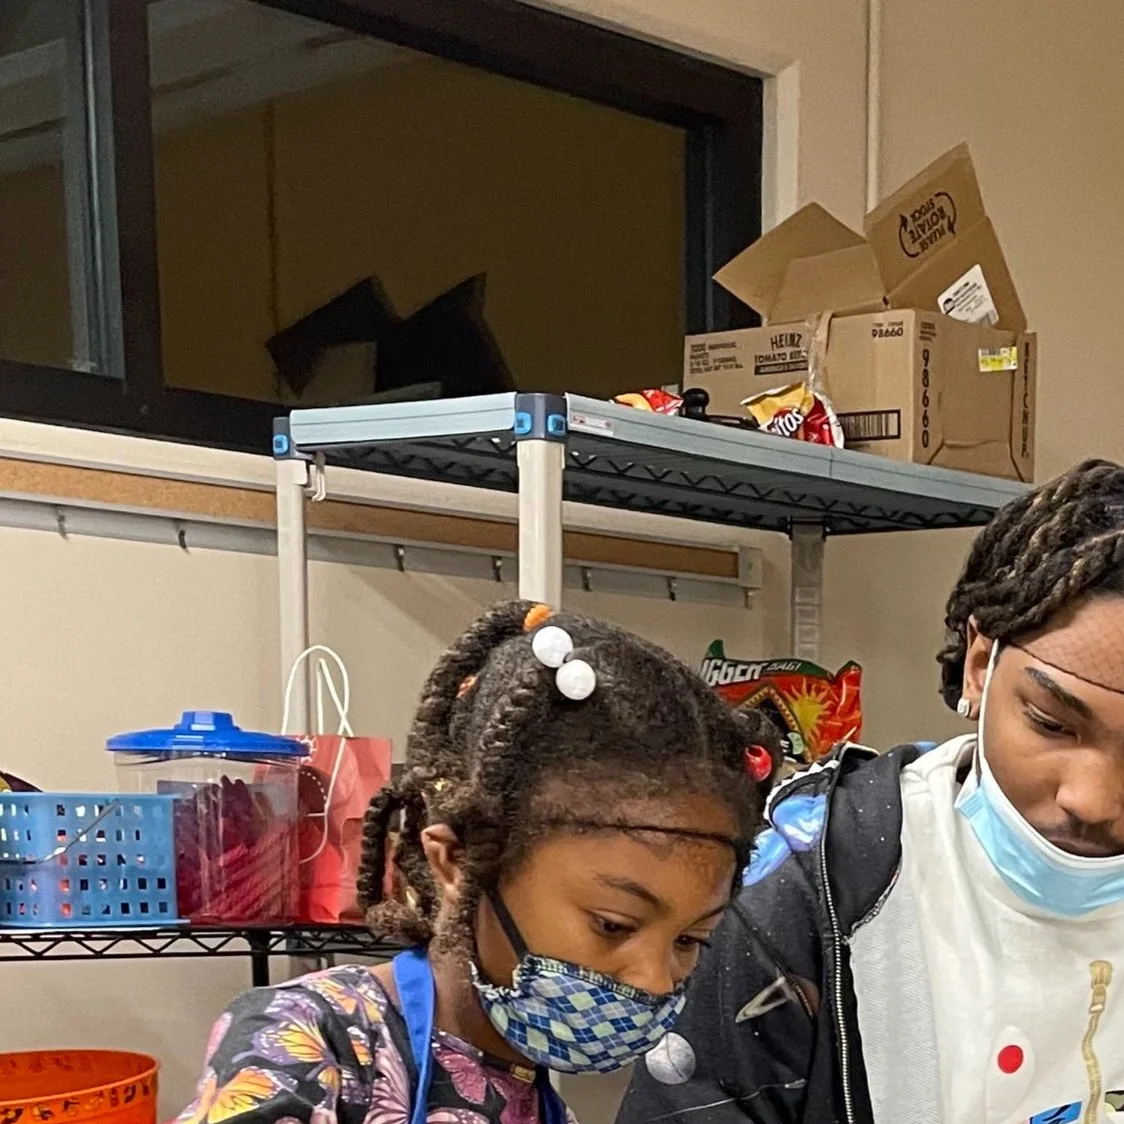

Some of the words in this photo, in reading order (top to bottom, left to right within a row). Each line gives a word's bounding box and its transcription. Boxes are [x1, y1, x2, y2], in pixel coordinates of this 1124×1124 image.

[910, 198, 936, 223] STOCK
[908, 206, 947, 245] ROTATE
[770, 332, 802, 351] HEINZ
[872, 327, 904, 338] 98660
[754, 352, 787, 364] TOMATO
[921, 348, 930, 448] 98660
